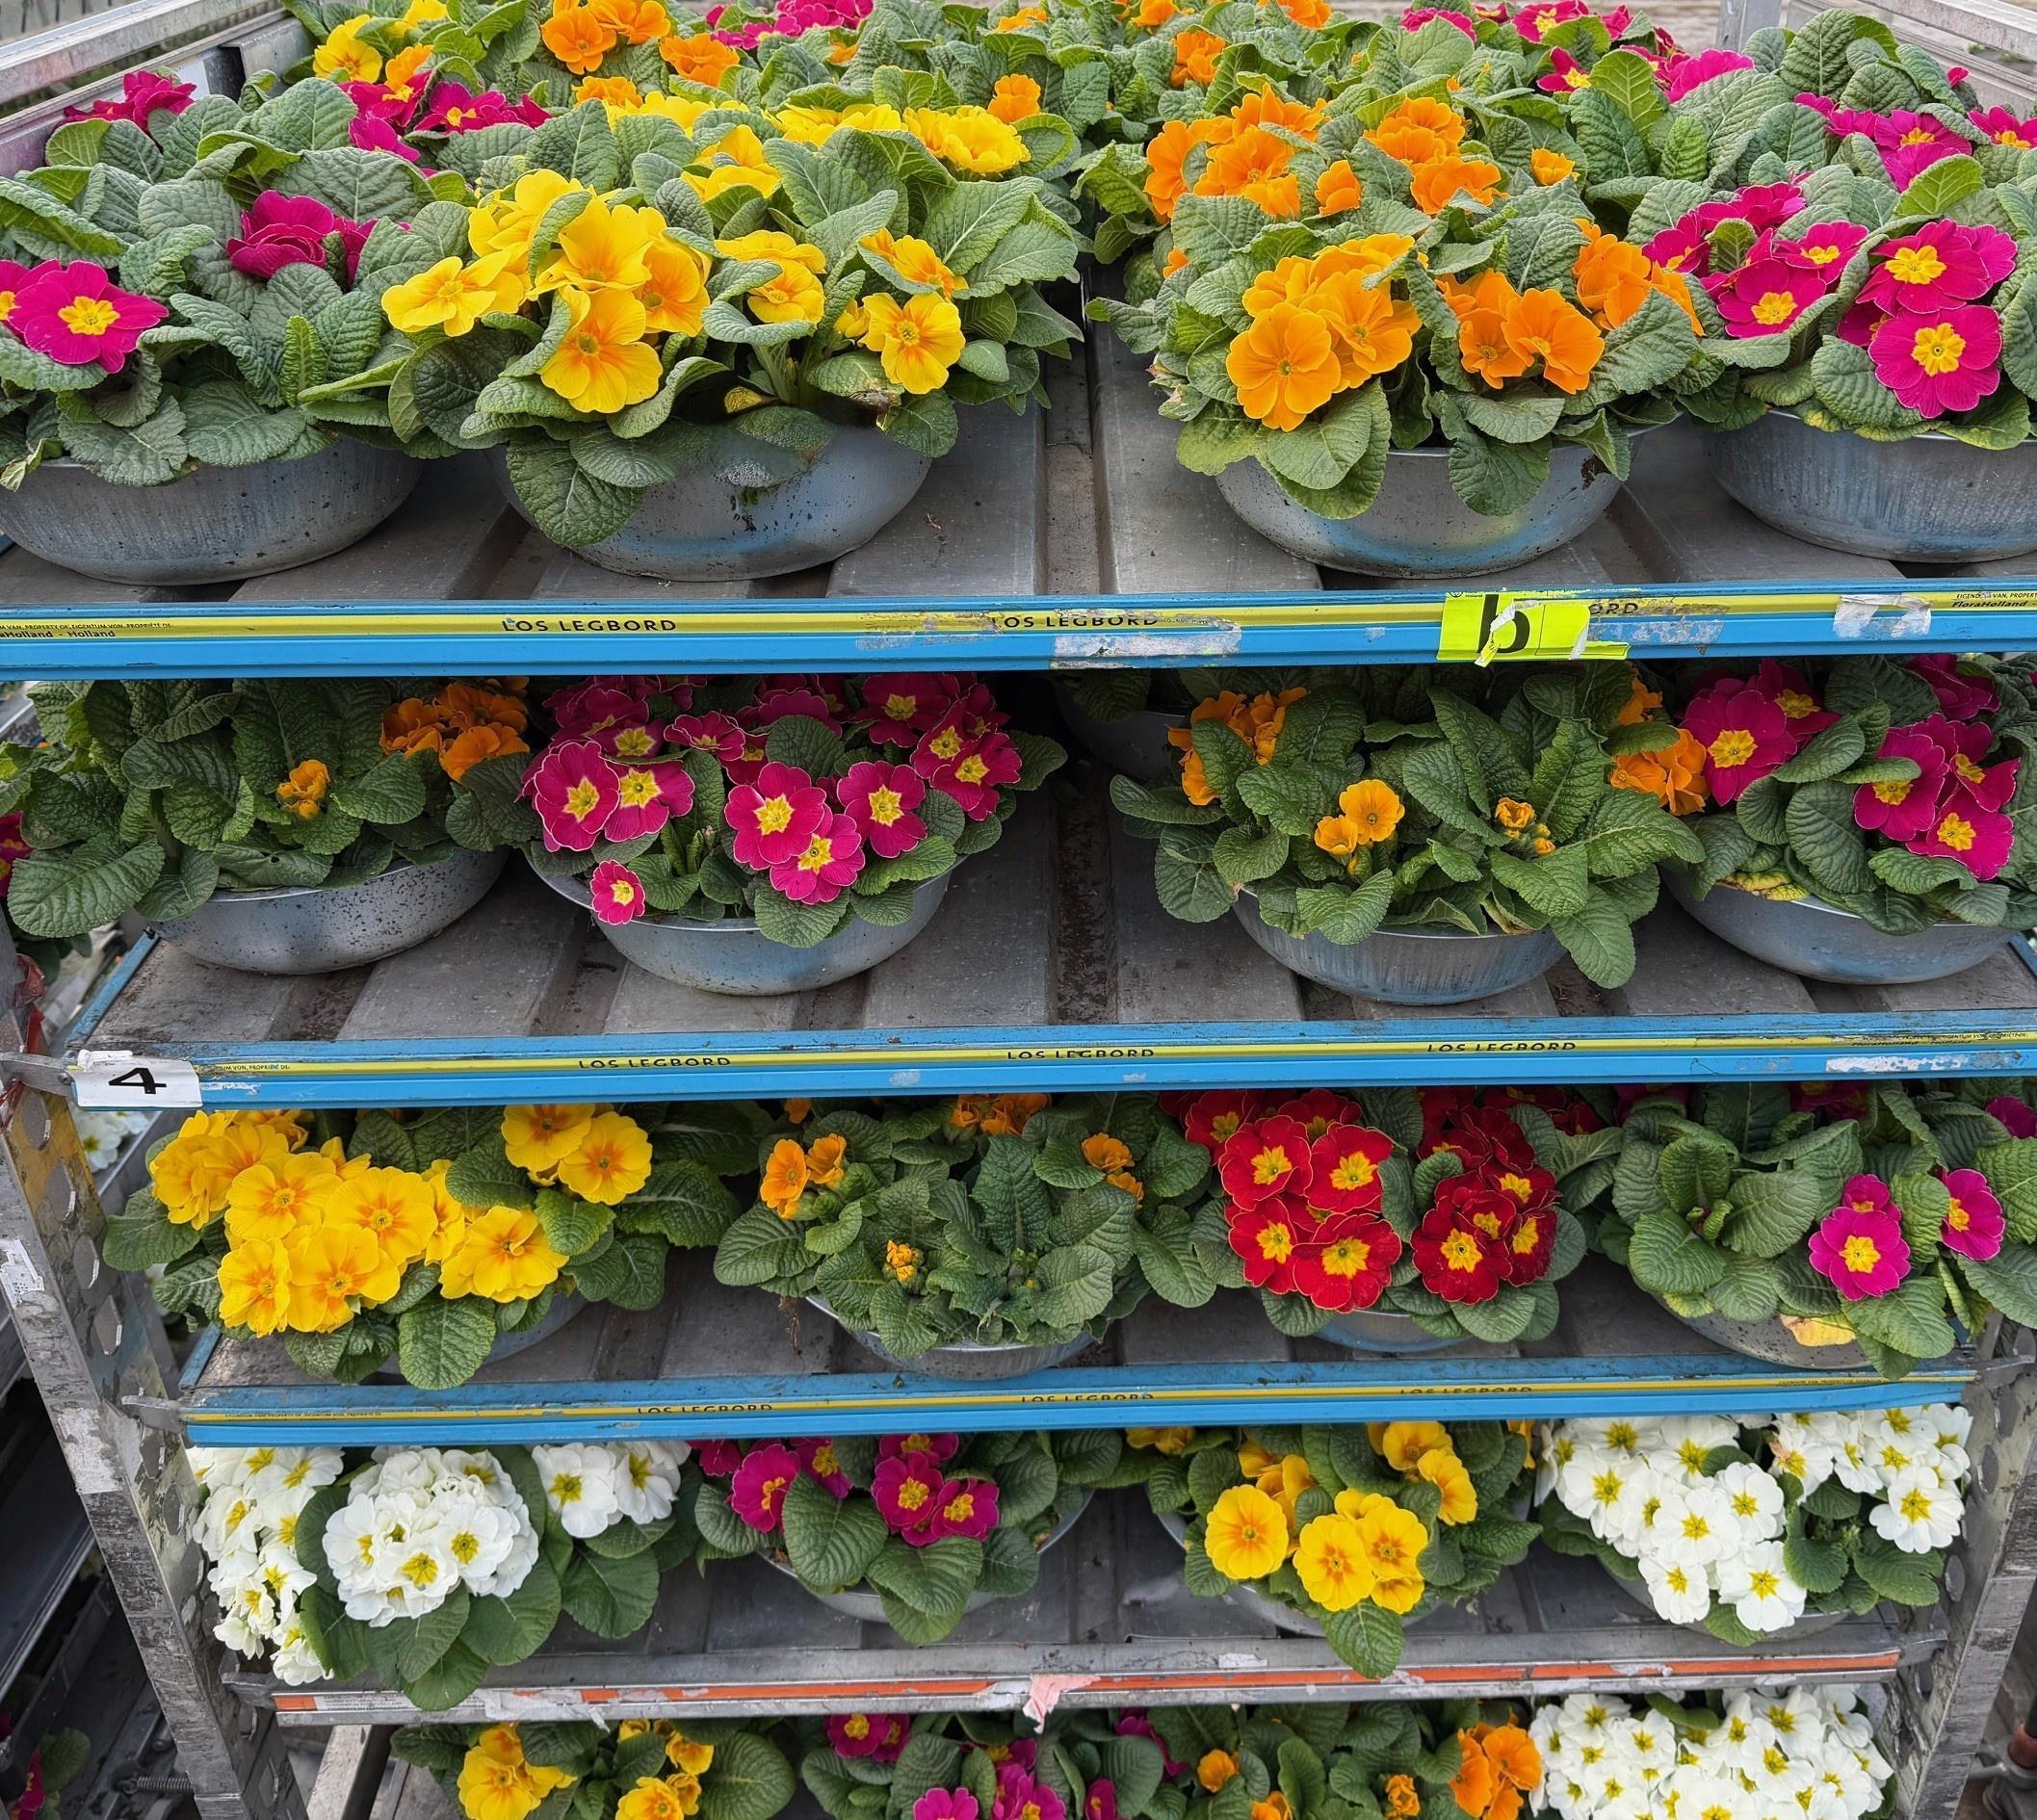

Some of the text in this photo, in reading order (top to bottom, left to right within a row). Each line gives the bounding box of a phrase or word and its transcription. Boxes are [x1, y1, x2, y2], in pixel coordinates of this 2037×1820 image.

[502, 619, 677, 632] LOS LEGBORD
[1046, 615, 1159, 628] LEGBORD
[1426, 1042, 1577, 1053] LOS LEGBORD
[1006, 1048, 1156, 1060] LOS LEGBORD
[578, 1057, 732, 1069] LOS LEGBORD
[108, 1067, 169, 1095] 4
